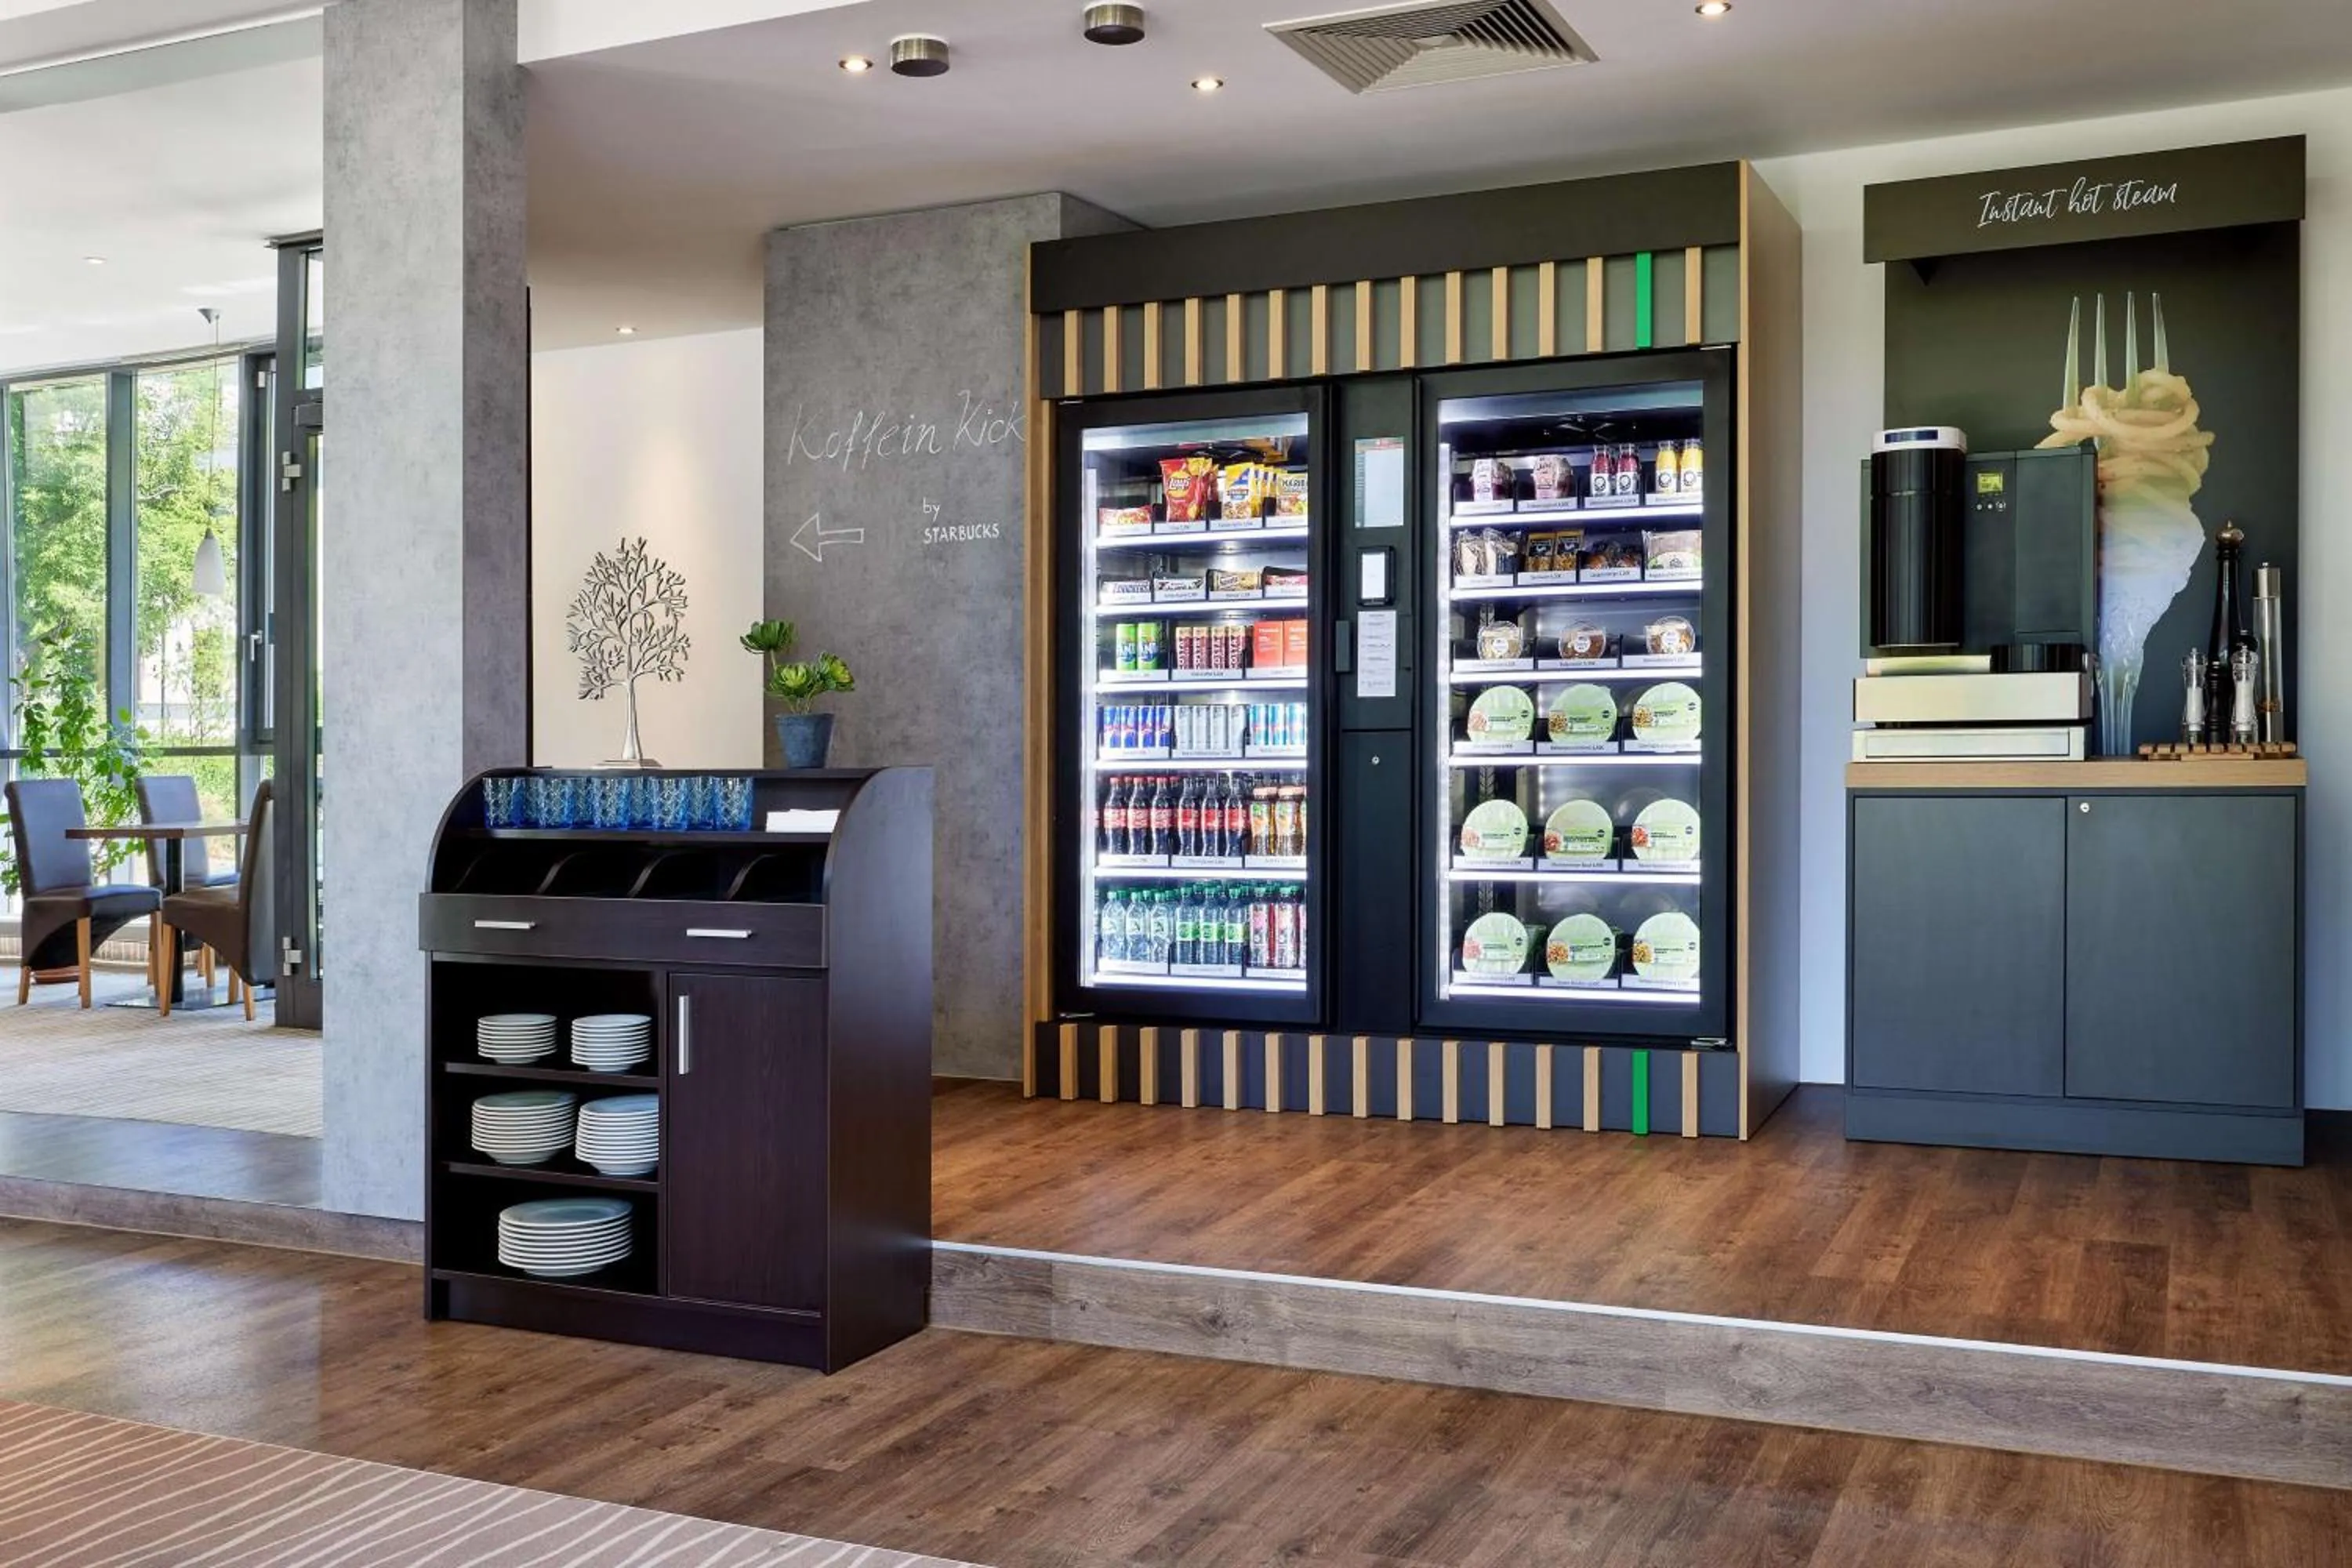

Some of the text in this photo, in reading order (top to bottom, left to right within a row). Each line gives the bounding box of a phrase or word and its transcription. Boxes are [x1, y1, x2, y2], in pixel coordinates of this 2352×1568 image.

[1976, 176, 2178, 228] Instant hot steam
[788, 390, 1027, 472] Koffein Kick
[923, 496, 941, 522] by
[924, 523, 1000, 544] STARBUCKS
